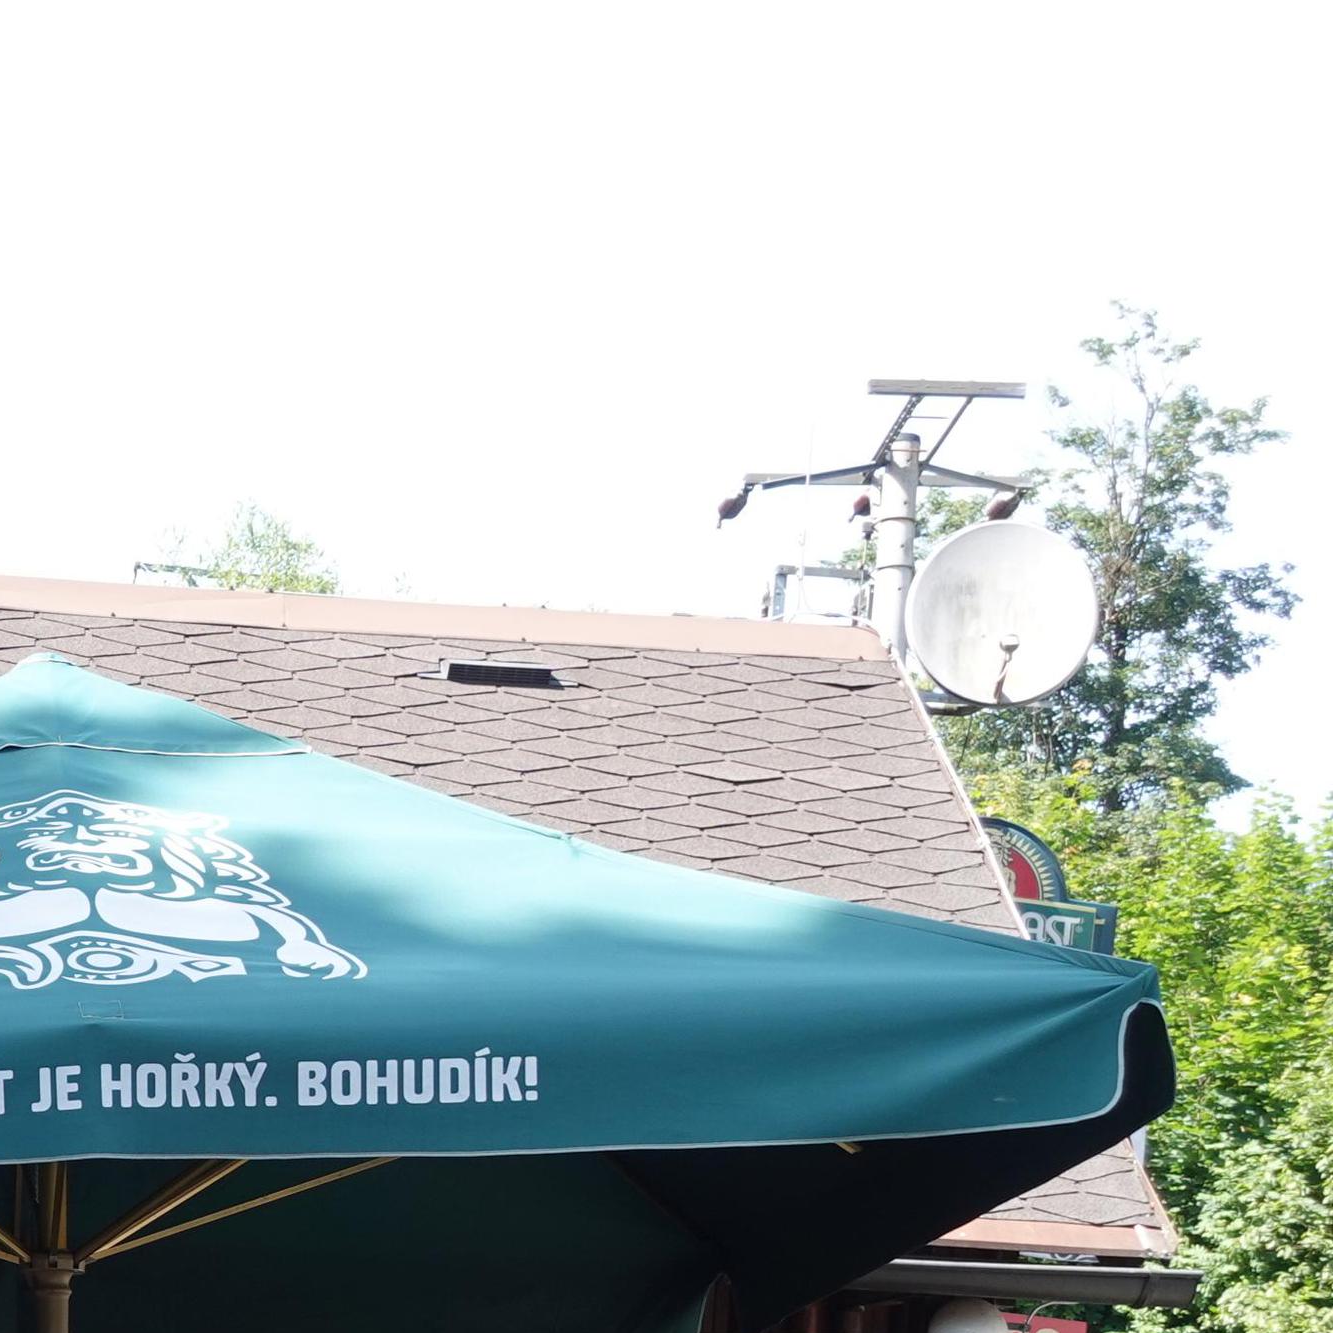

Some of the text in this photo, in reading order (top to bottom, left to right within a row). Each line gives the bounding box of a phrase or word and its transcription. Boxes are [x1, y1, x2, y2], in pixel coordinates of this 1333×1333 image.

[31, 1065, 83, 1113] JE
[99, 1052, 278, 1108] HOŘKÝ.
[297, 1047, 539, 1107] BOHUDÍK!
